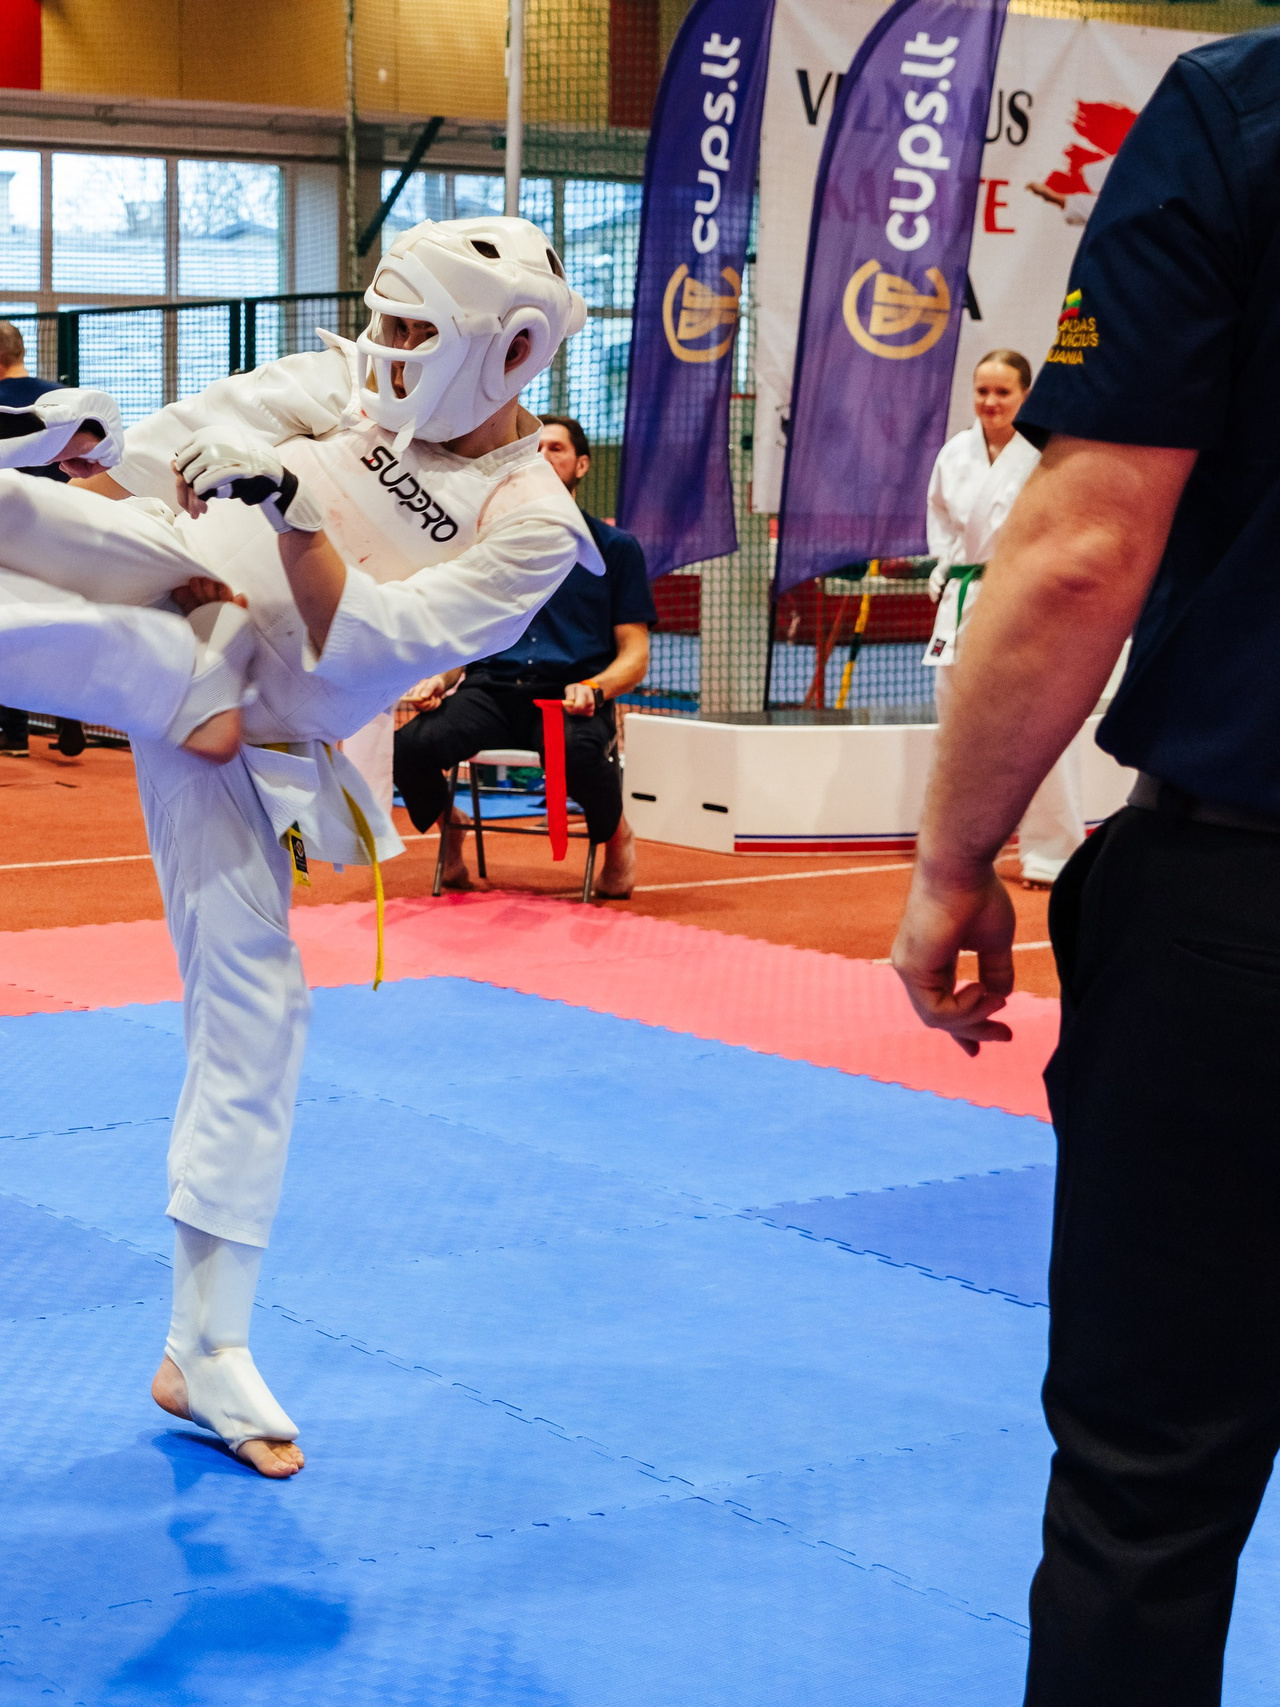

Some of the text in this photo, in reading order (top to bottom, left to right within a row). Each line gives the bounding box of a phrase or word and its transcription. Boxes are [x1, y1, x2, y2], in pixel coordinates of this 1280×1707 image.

[692, 33, 741, 253] cups.lt
[886, 32, 959, 251] cups.lt
[360, 446, 459, 542] SUPPRO
